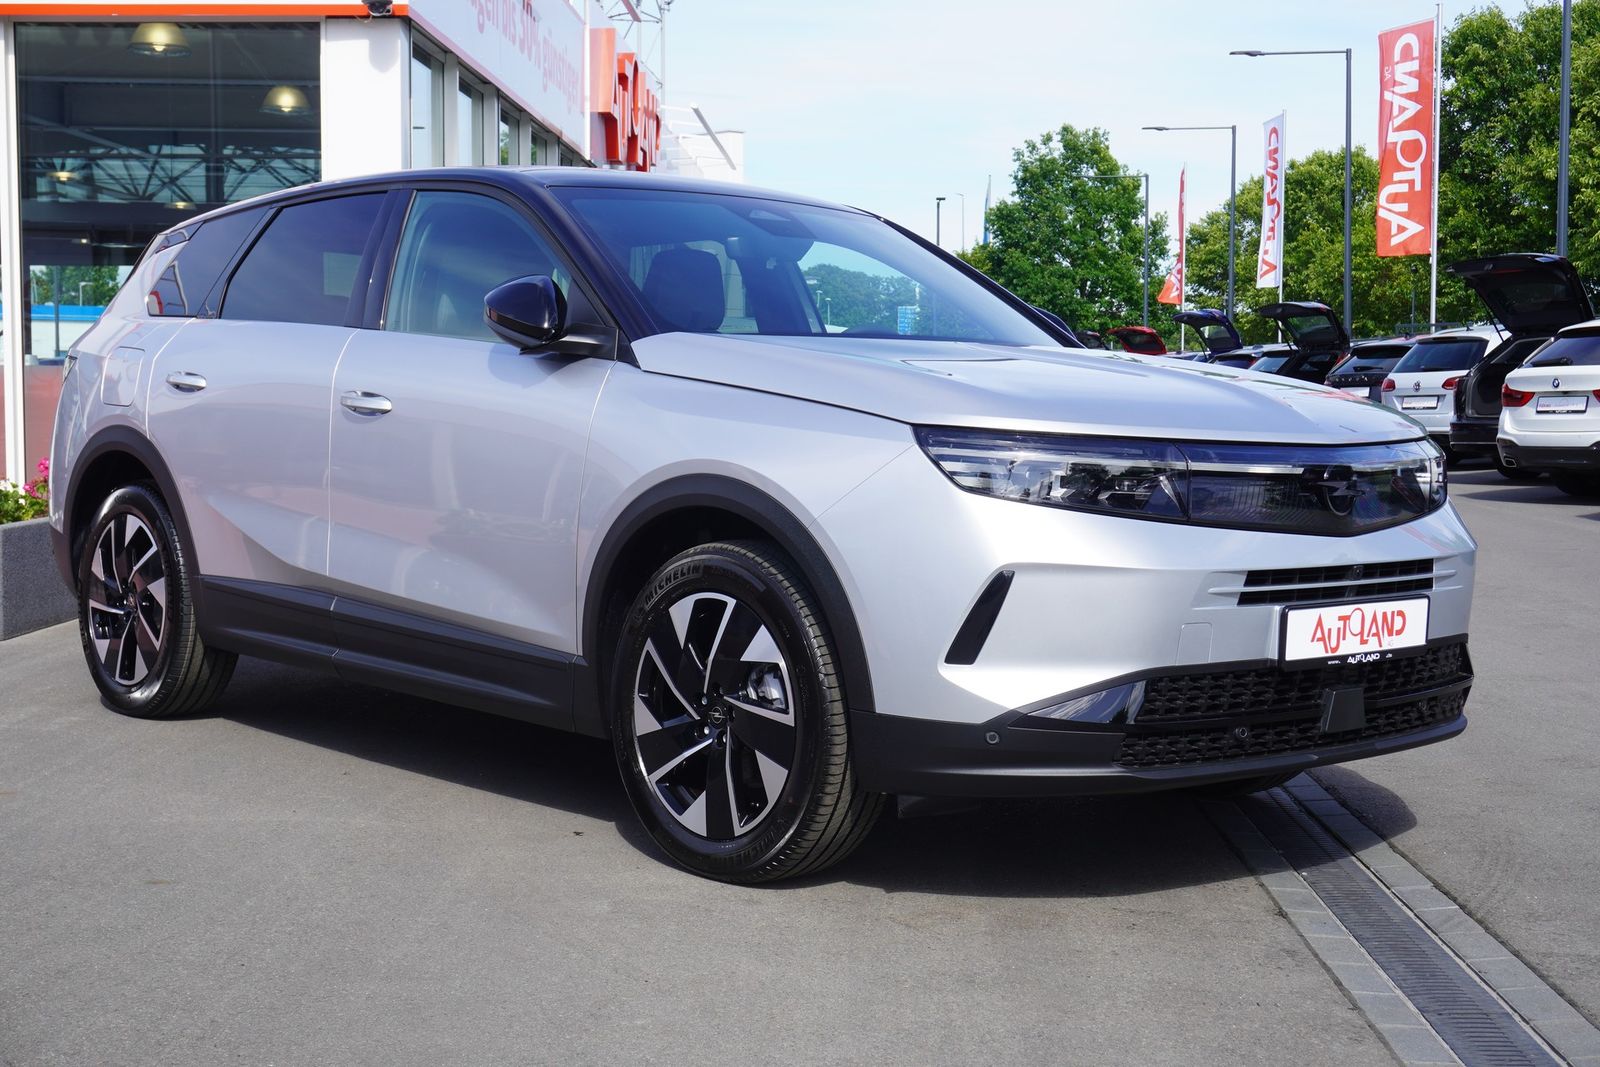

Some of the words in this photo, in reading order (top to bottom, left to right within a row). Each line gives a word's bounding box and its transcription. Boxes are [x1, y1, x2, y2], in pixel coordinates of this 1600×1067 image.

[645, 562, 701, 604] MICHELIN
[1311, 607, 1407, 654] AUTOLAND
[1347, 653, 1380, 664] AUTOLAND
